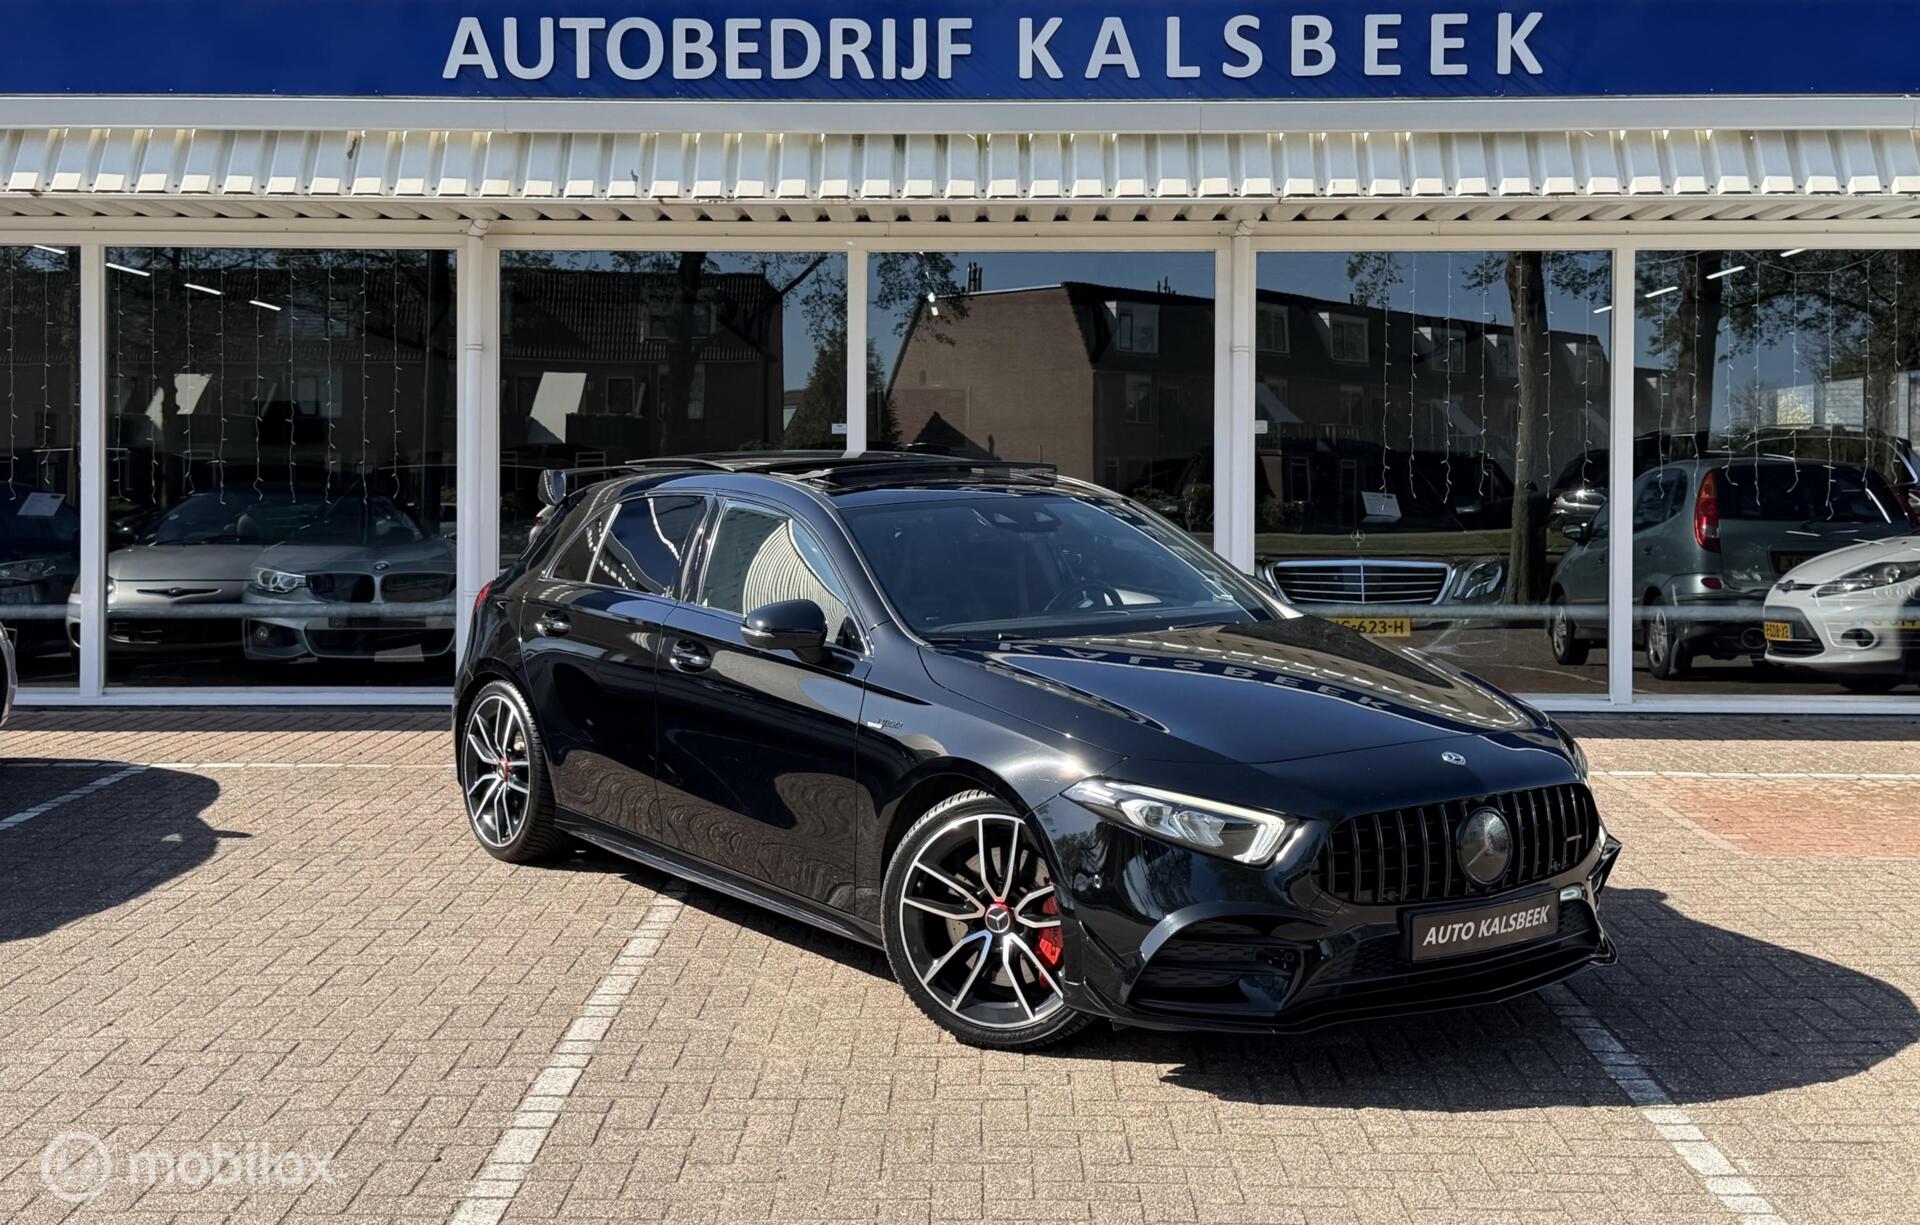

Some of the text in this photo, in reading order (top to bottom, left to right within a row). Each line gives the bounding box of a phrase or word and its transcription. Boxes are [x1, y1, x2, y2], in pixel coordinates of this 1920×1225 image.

[443, 12, 1544, 80] AUTOBEDRIJF KALSBEEK
[1422, 904, 1550, 946] AUTO KALSBEEK
